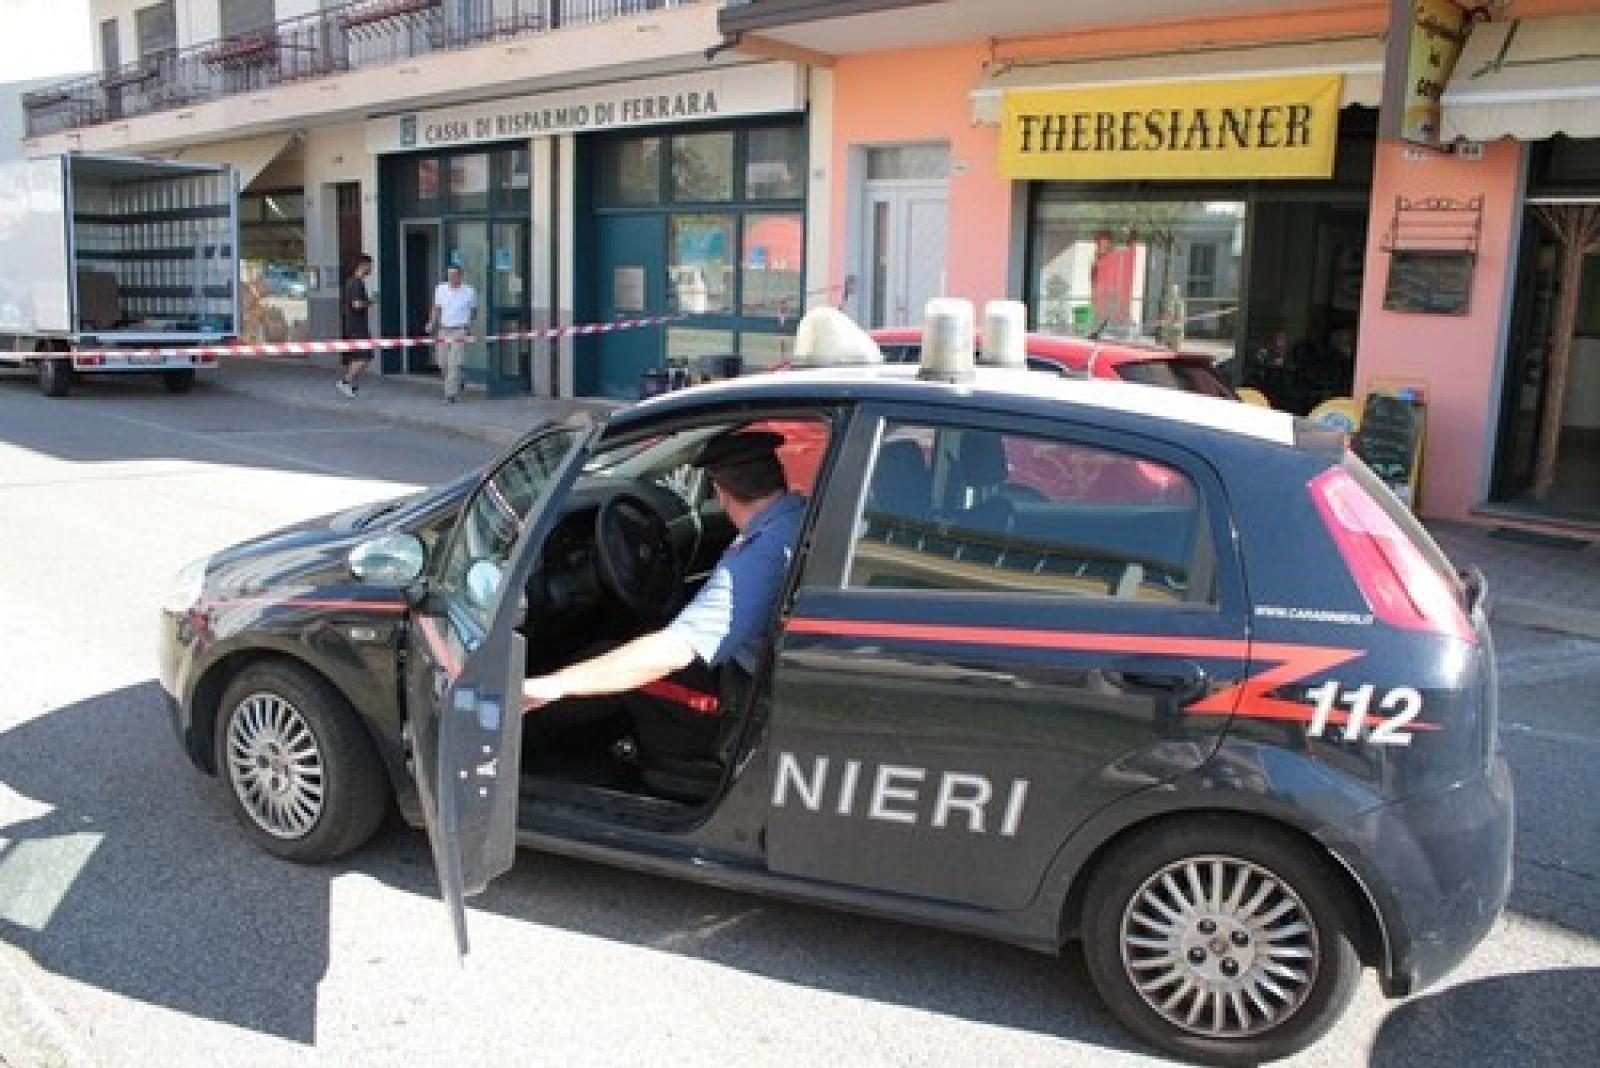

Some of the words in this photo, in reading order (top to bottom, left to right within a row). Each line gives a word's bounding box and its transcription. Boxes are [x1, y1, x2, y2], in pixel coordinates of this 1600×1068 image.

[425, 121, 468, 144] CASSA
[475, 118, 491, 138] DI
[496, 105, 589, 135] RISPARMIO
[595, 102, 614, 125] DI
[621, 90, 718, 122] FERRARA
[1017, 102, 1312, 153] THERESIANER
[1305, 681, 1423, 747] 112
[771, 752, 1030, 836] NIERI
